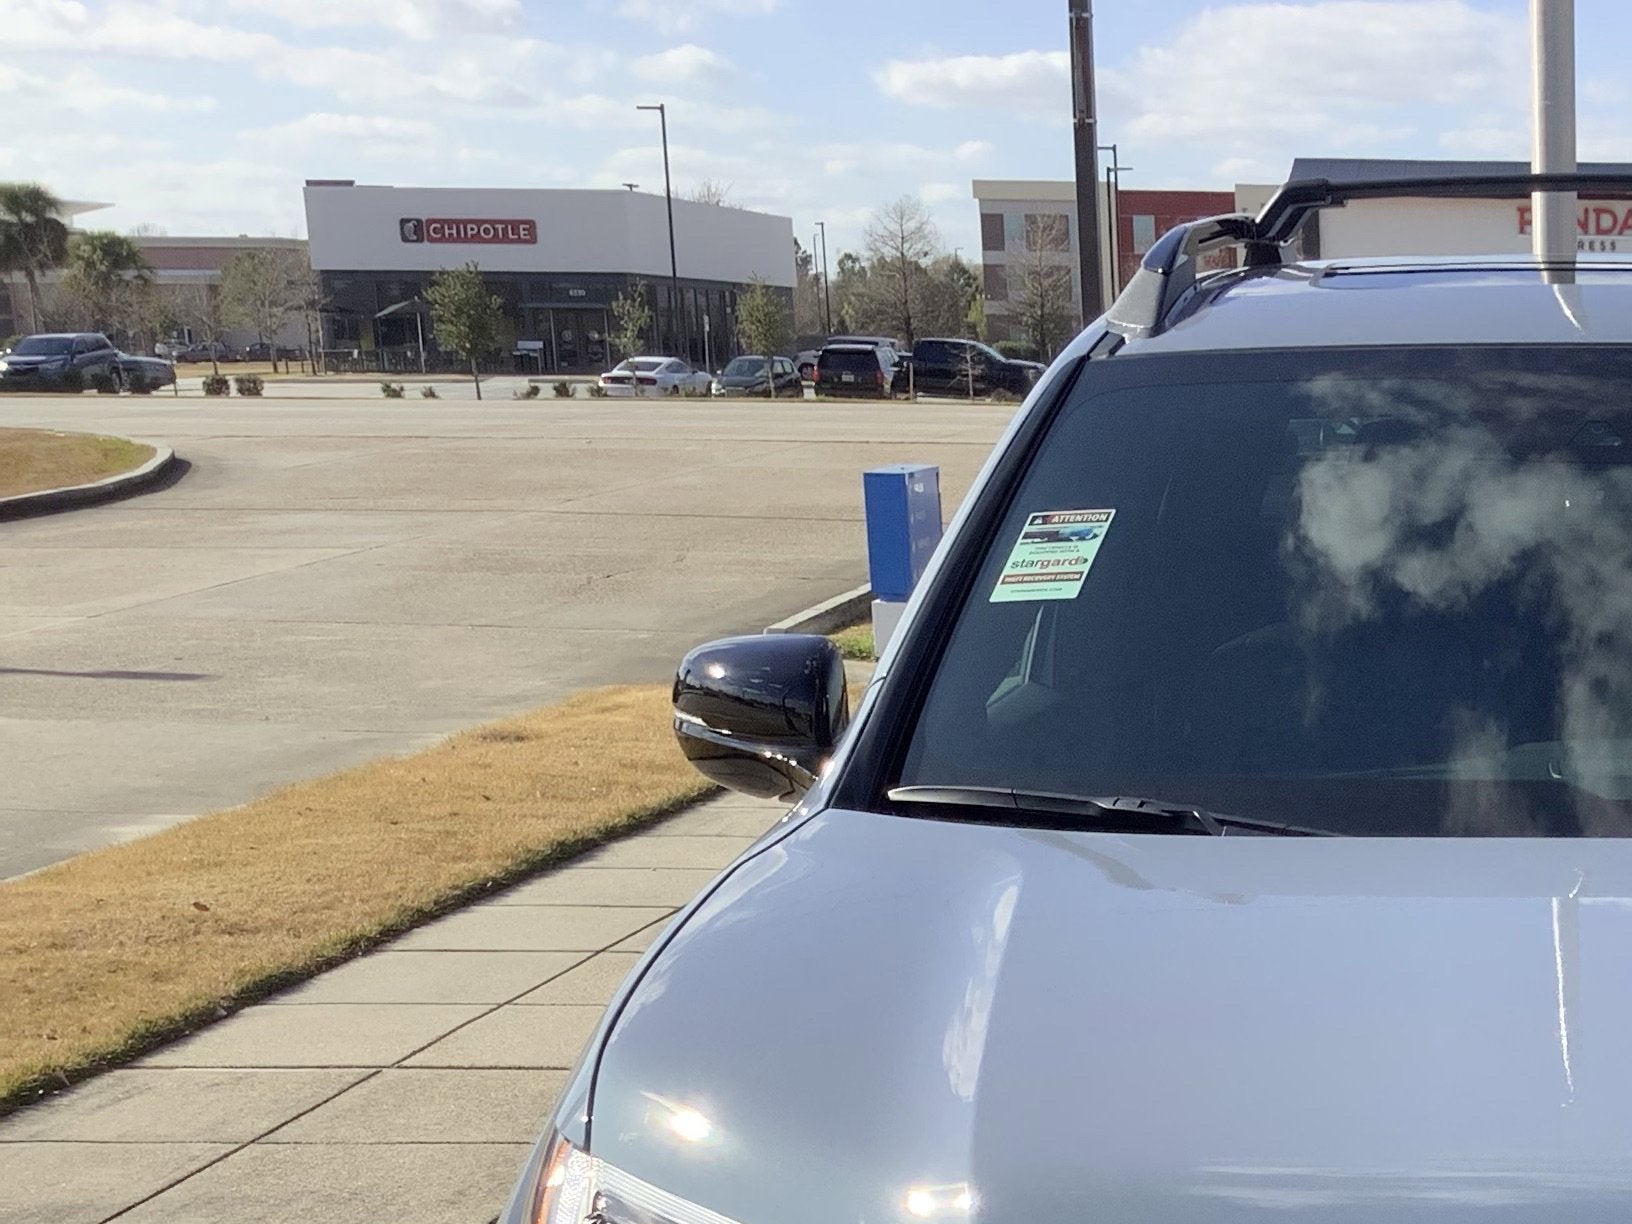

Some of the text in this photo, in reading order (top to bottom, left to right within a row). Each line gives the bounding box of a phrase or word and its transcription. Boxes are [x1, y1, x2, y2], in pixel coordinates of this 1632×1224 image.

[429, 223, 531, 240] CHIPOTLE
[1052, 513, 1108, 523] ATTENTION
[1010, 556, 1080, 569] stargard
